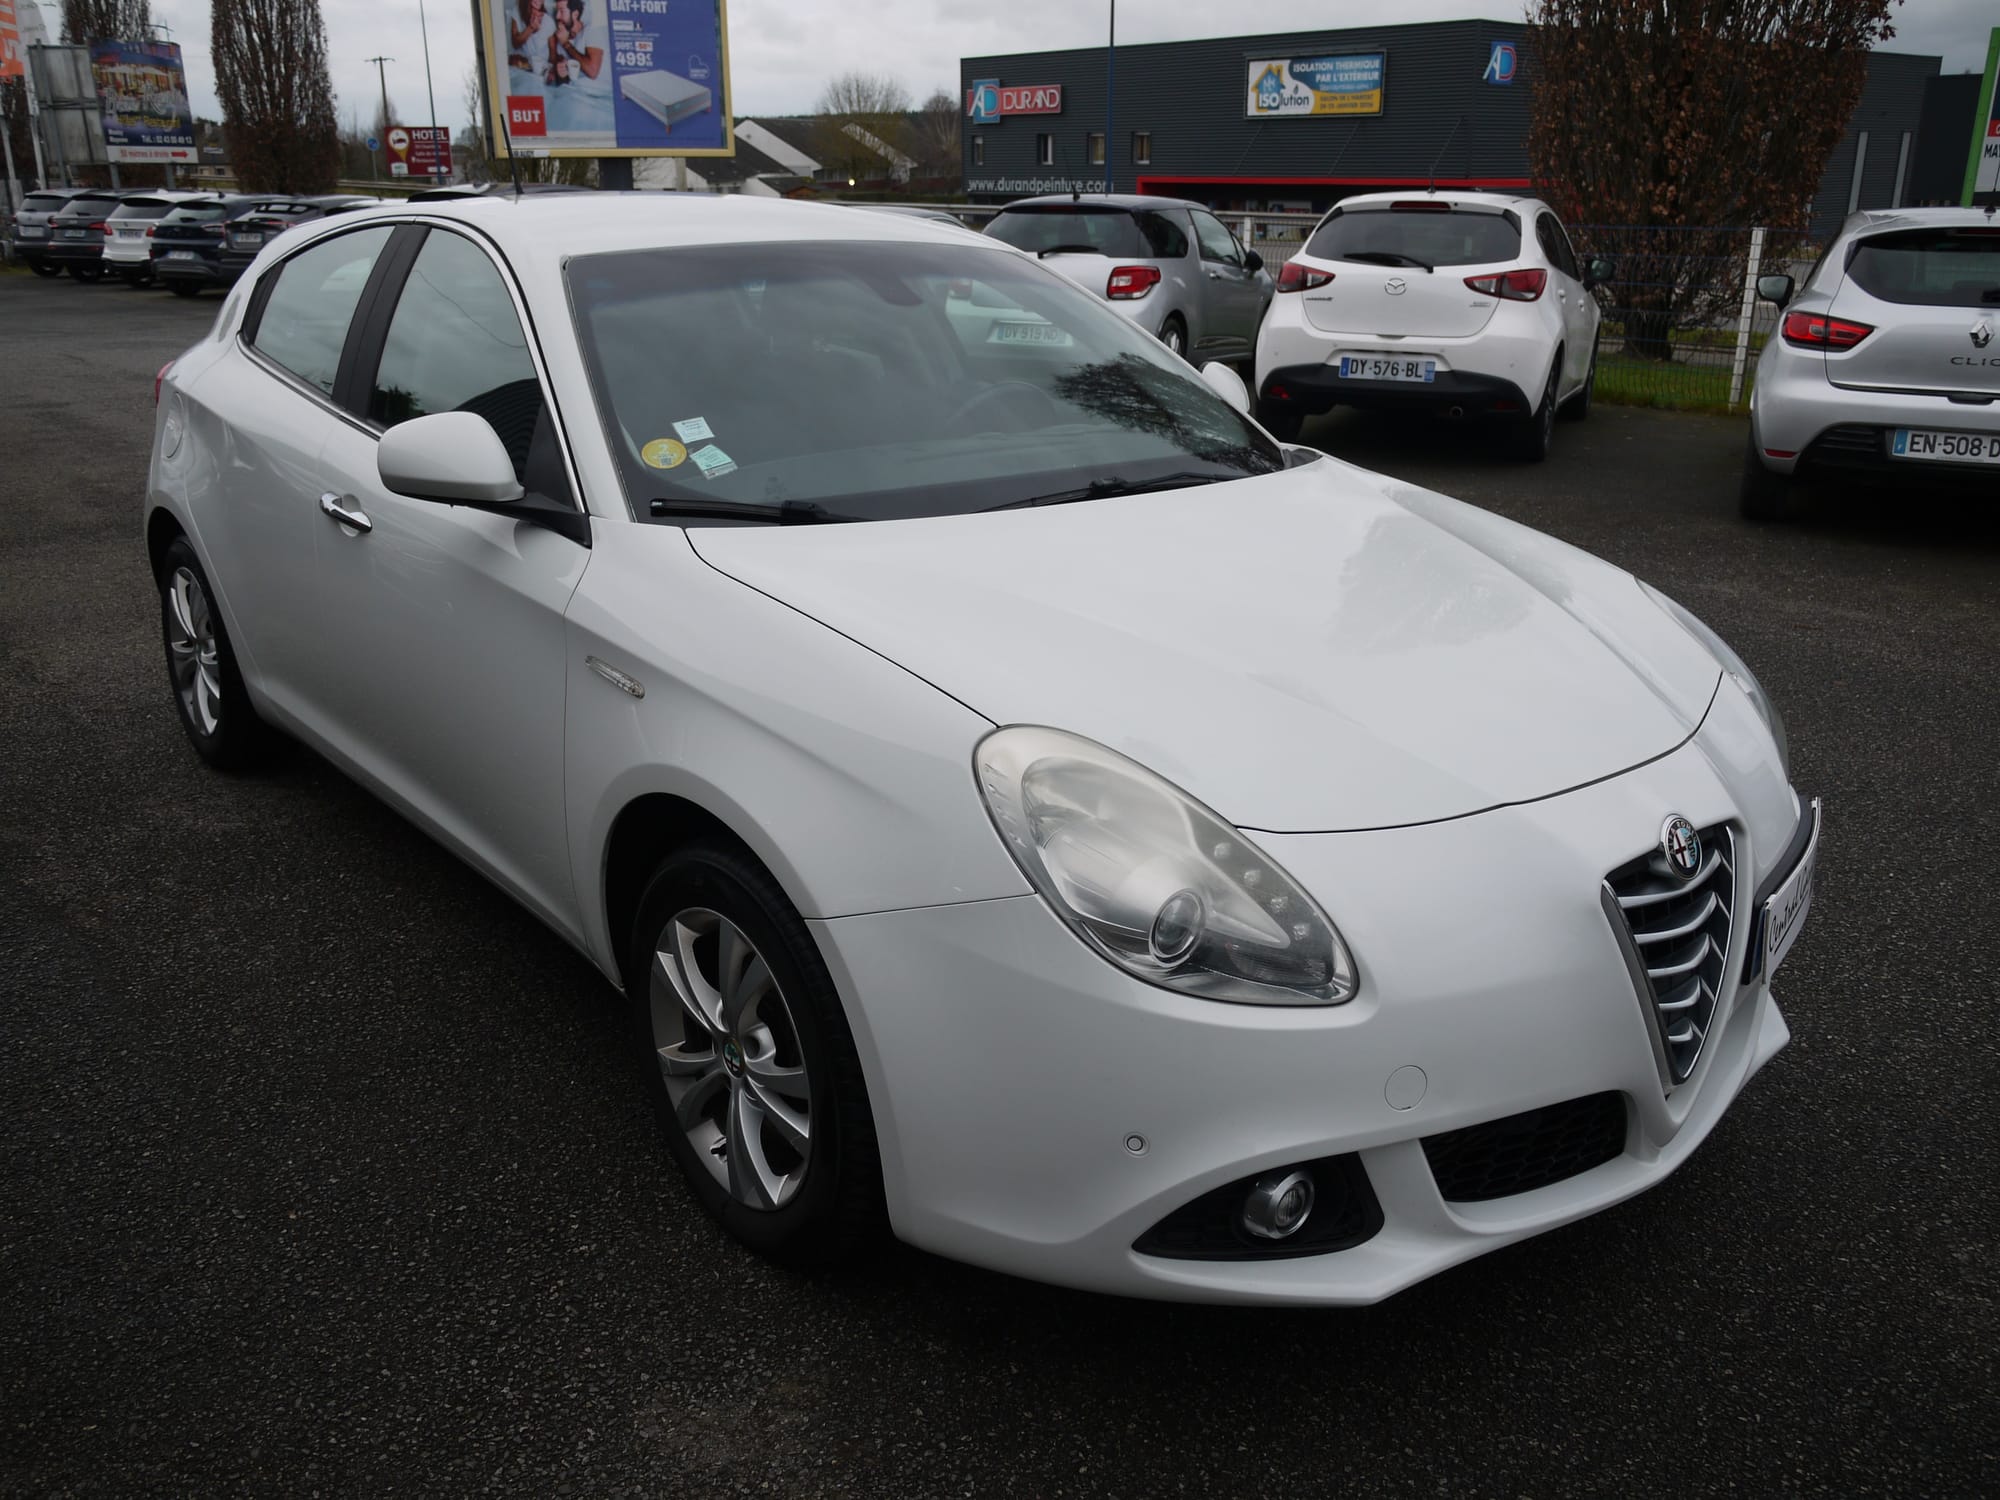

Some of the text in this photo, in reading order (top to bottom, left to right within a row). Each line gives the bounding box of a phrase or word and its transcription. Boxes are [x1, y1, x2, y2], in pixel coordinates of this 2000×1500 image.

[1293, 59, 1380, 73] ISOLATION THERMIQUE
[1482, 45, 1518, 81] AD
[1315, 73, 1332, 82] PAR
[1002, 89, 1060, 110] DURAND
[512, 109, 541, 123] BUT
[1350, 358, 1422, 379] DY-576-BL
